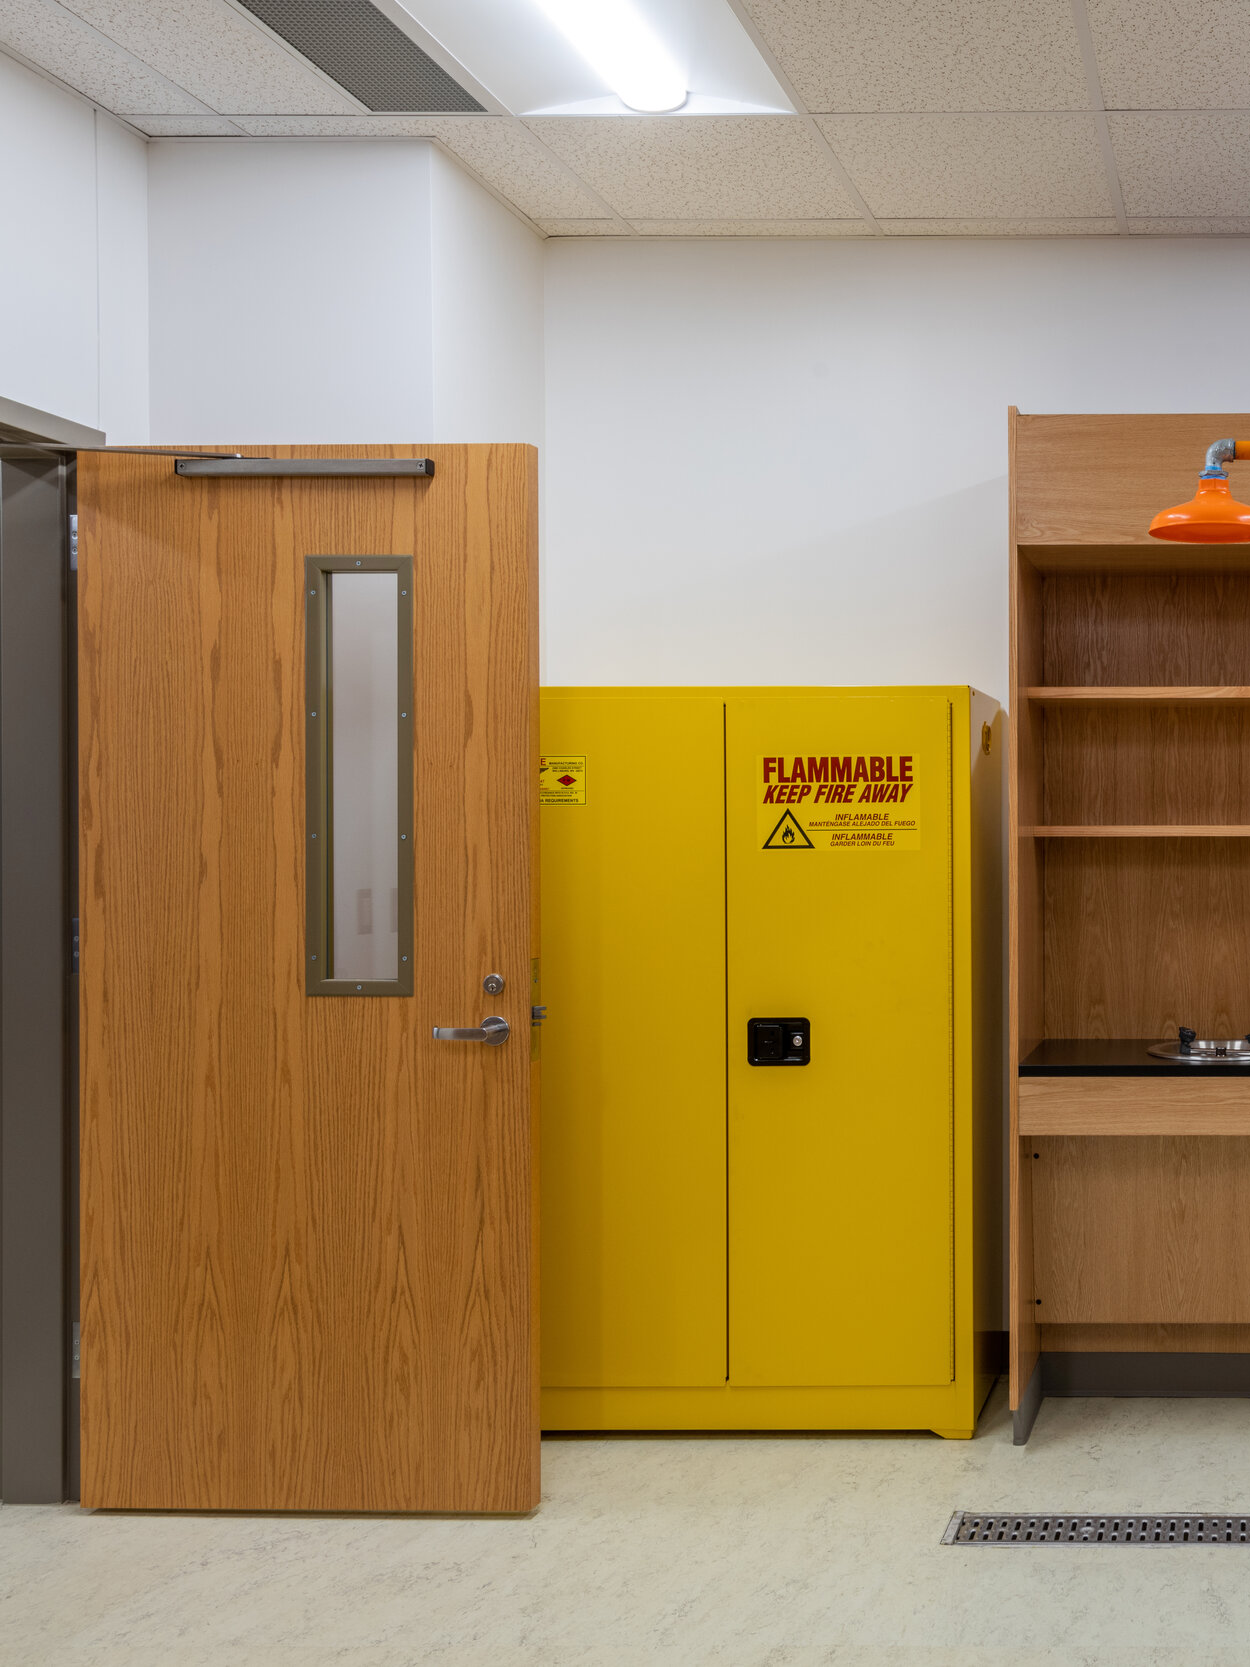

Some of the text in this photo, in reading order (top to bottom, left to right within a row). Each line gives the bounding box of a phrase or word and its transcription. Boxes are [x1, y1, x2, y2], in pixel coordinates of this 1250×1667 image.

[763, 756, 914, 783] FLAMMABLE
[763, 783, 914, 804] KEEP FIRE AWAY
[835, 813, 890, 821] INFLAMABLE
[832, 833, 893, 841] INFLAMMABLE
